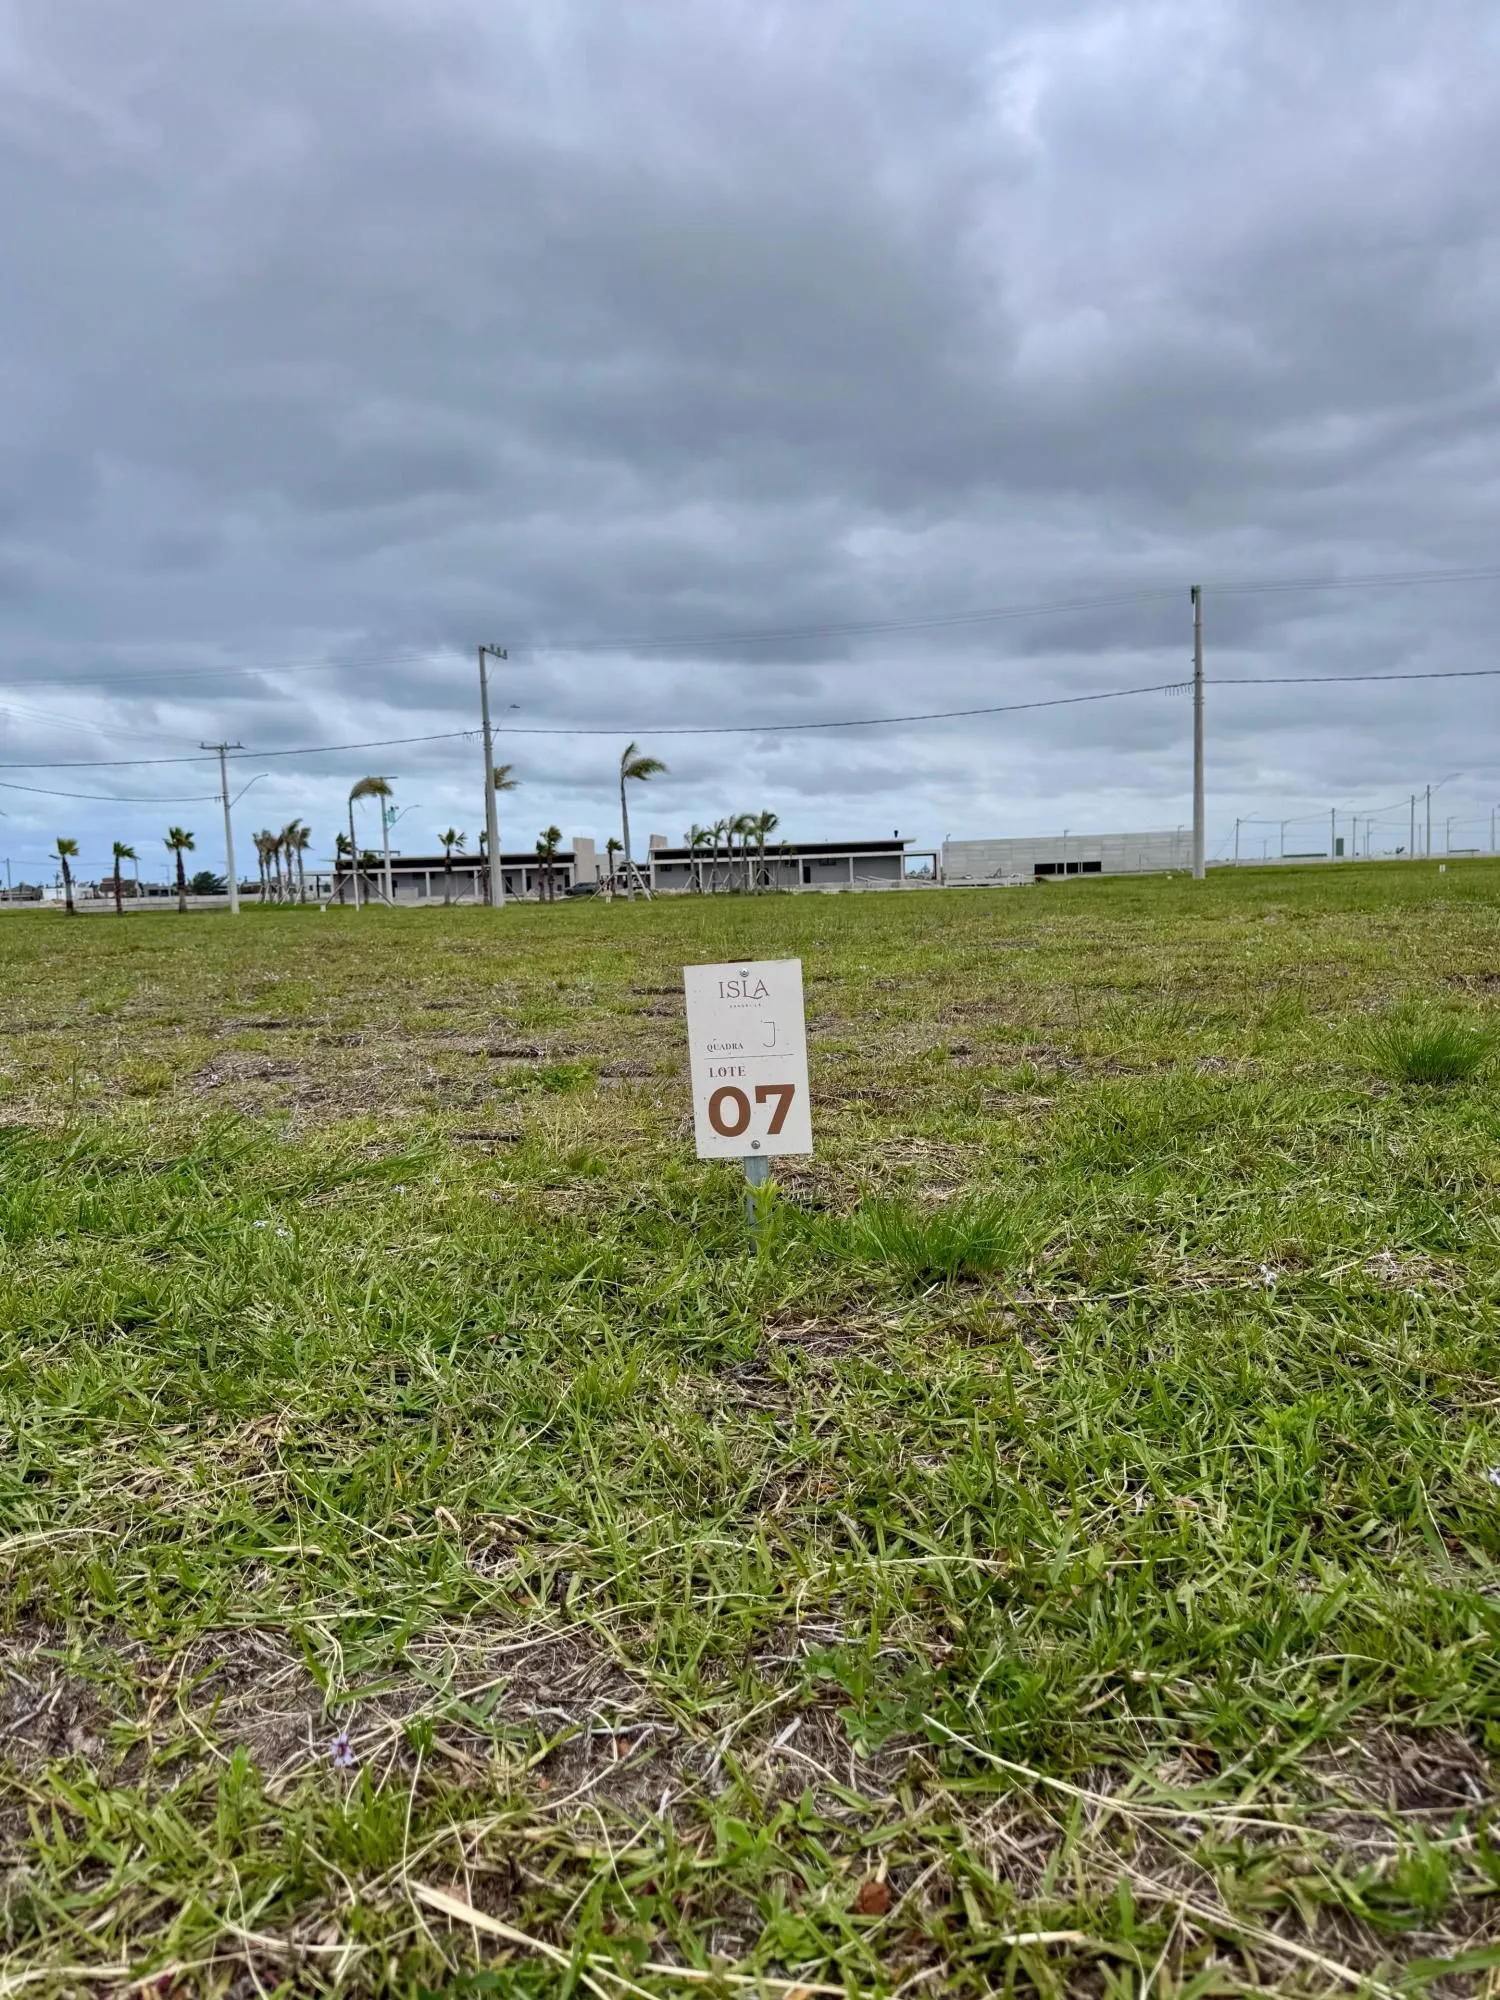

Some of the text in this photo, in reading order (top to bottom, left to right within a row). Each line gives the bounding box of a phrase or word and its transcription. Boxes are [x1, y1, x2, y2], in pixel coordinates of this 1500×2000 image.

[719, 980, 770, 999] ISLA
[706, 1021, 776, 1052] QUADRA J
[709, 1065, 747, 1078] LOTE
[708, 1084, 796, 1137] 07
